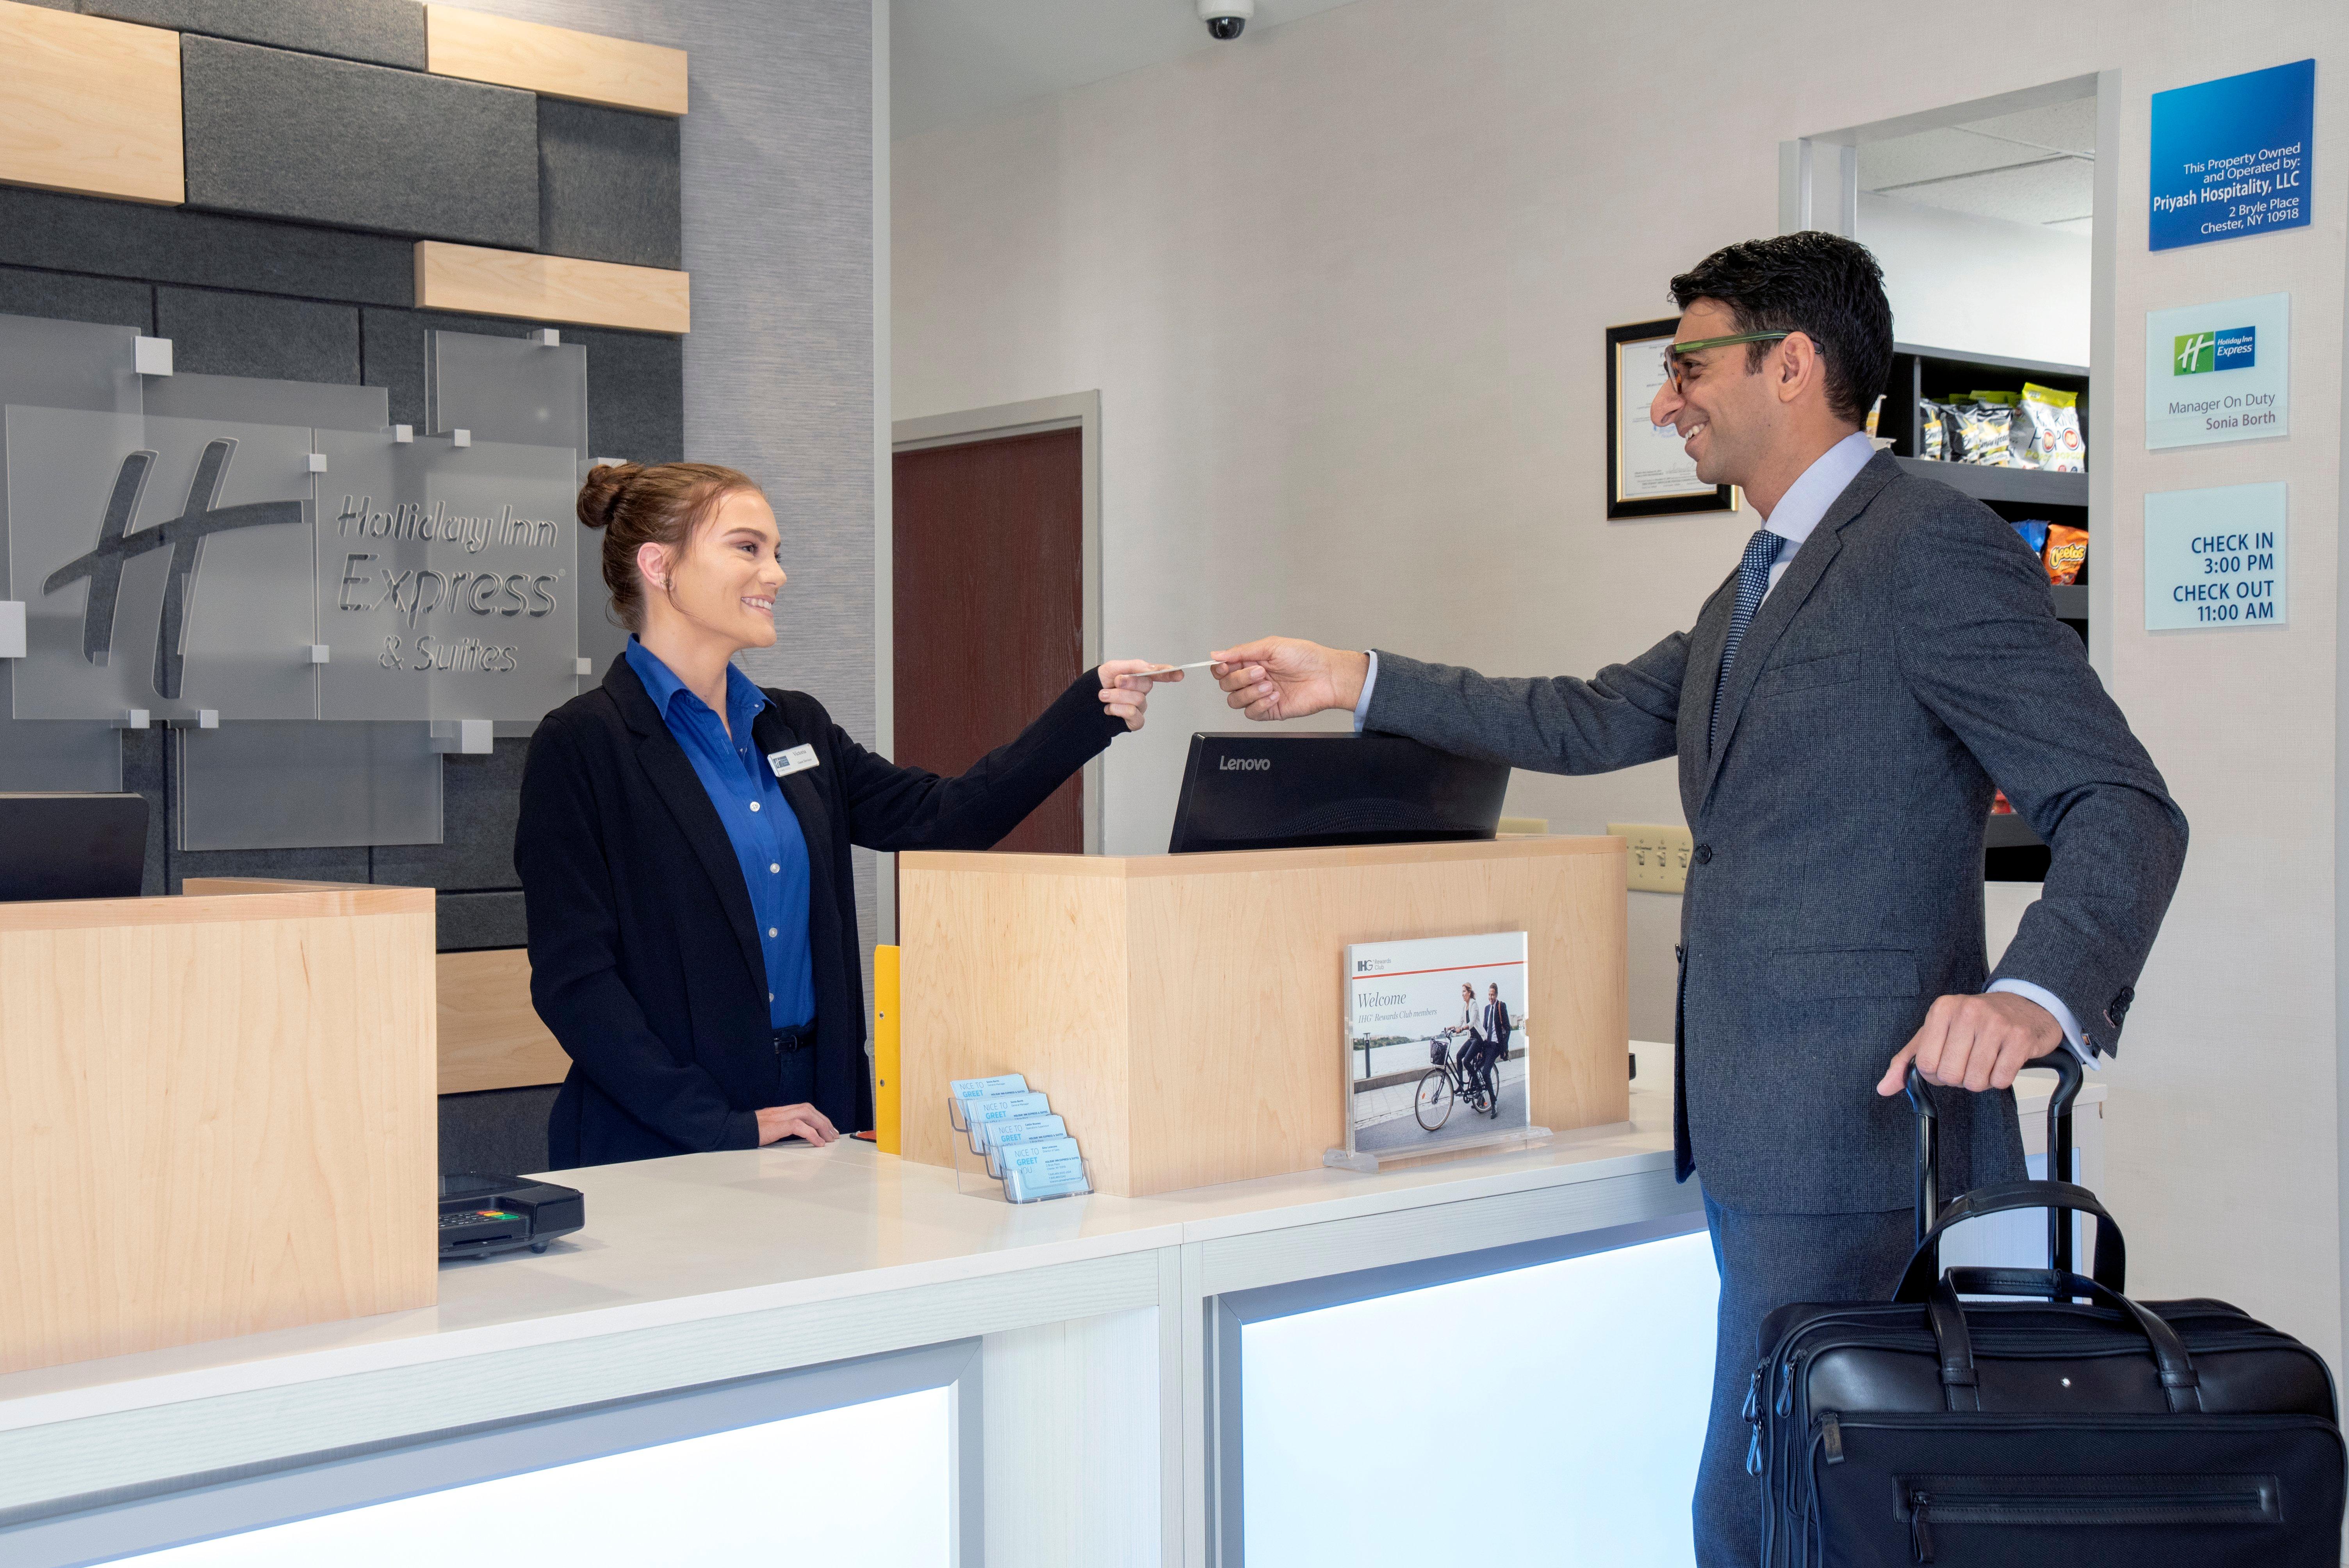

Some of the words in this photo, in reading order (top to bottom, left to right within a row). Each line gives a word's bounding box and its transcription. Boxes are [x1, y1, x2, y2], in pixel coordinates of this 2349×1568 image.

[2183, 162, 2205, 175] This
[2208, 153, 2256, 170] Property
[2258, 142, 2301, 160] Owned
[2203, 169, 2224, 184] and
[2227, 159, 2279, 179] Operated
[2283, 157, 2301, 170] by:
[2153, 190, 2196, 213] Priyash
[2201, 178, 2272, 203] Hospitality,
[2276, 171, 2299, 189] LLC
[2229, 207, 2236, 217] 2
[2239, 200, 2267, 217] Bryle
[2270, 197, 2299, 210] Place
[2201, 219, 2244, 234] Chester,
[2247, 214, 2263, 226] NY
[2267, 208, 2299, 223] 10918
[2217, 345, 2253, 357] Express
[2169, 399, 2220, 414] Manager
[2224, 396, 2241, 408] On
[2246, 393, 2276, 407] Duty
[2206, 415, 2238, 430] Sonia
[2243, 411, 2276, 426] Borth
[337, 495, 493, 554] Holiday
[498, 504, 558, 547] Inn
[2191, 533, 2248, 554] CHECK
[2256, 532, 2273, 549] IN
[2204, 556, 2240, 574] 3:00
[2247, 553, 2273, 571] PM
[338, 553, 558, 630] Express
[2173, 583, 2230, 602] CHECK
[2237, 580, 2274, 598] OUT
[2198, 604, 2239, 622] 11:00
[2246, 602, 2273, 619] AM
[379, 635, 404, 670] &
[413, 636, 518, 672] Suites
[1219, 755, 1271, 770] Lenovo
[1358, 960, 1373, 971] IHG
[1358, 992, 1406, 1008] Welcome
[1374, 1012, 1398, 1021] Rewards
[1399, 1010, 1412, 1019] Club
[1413, 1008, 1437, 1017] members
[962, 1090, 983, 1098] GREET
[986, 1111, 1006, 1119] GREET
[1001, 1133, 1021, 1142] GREET
[1015, 1149, 1029, 1158] NICE
[1017, 1157, 1037, 1165] GREET
